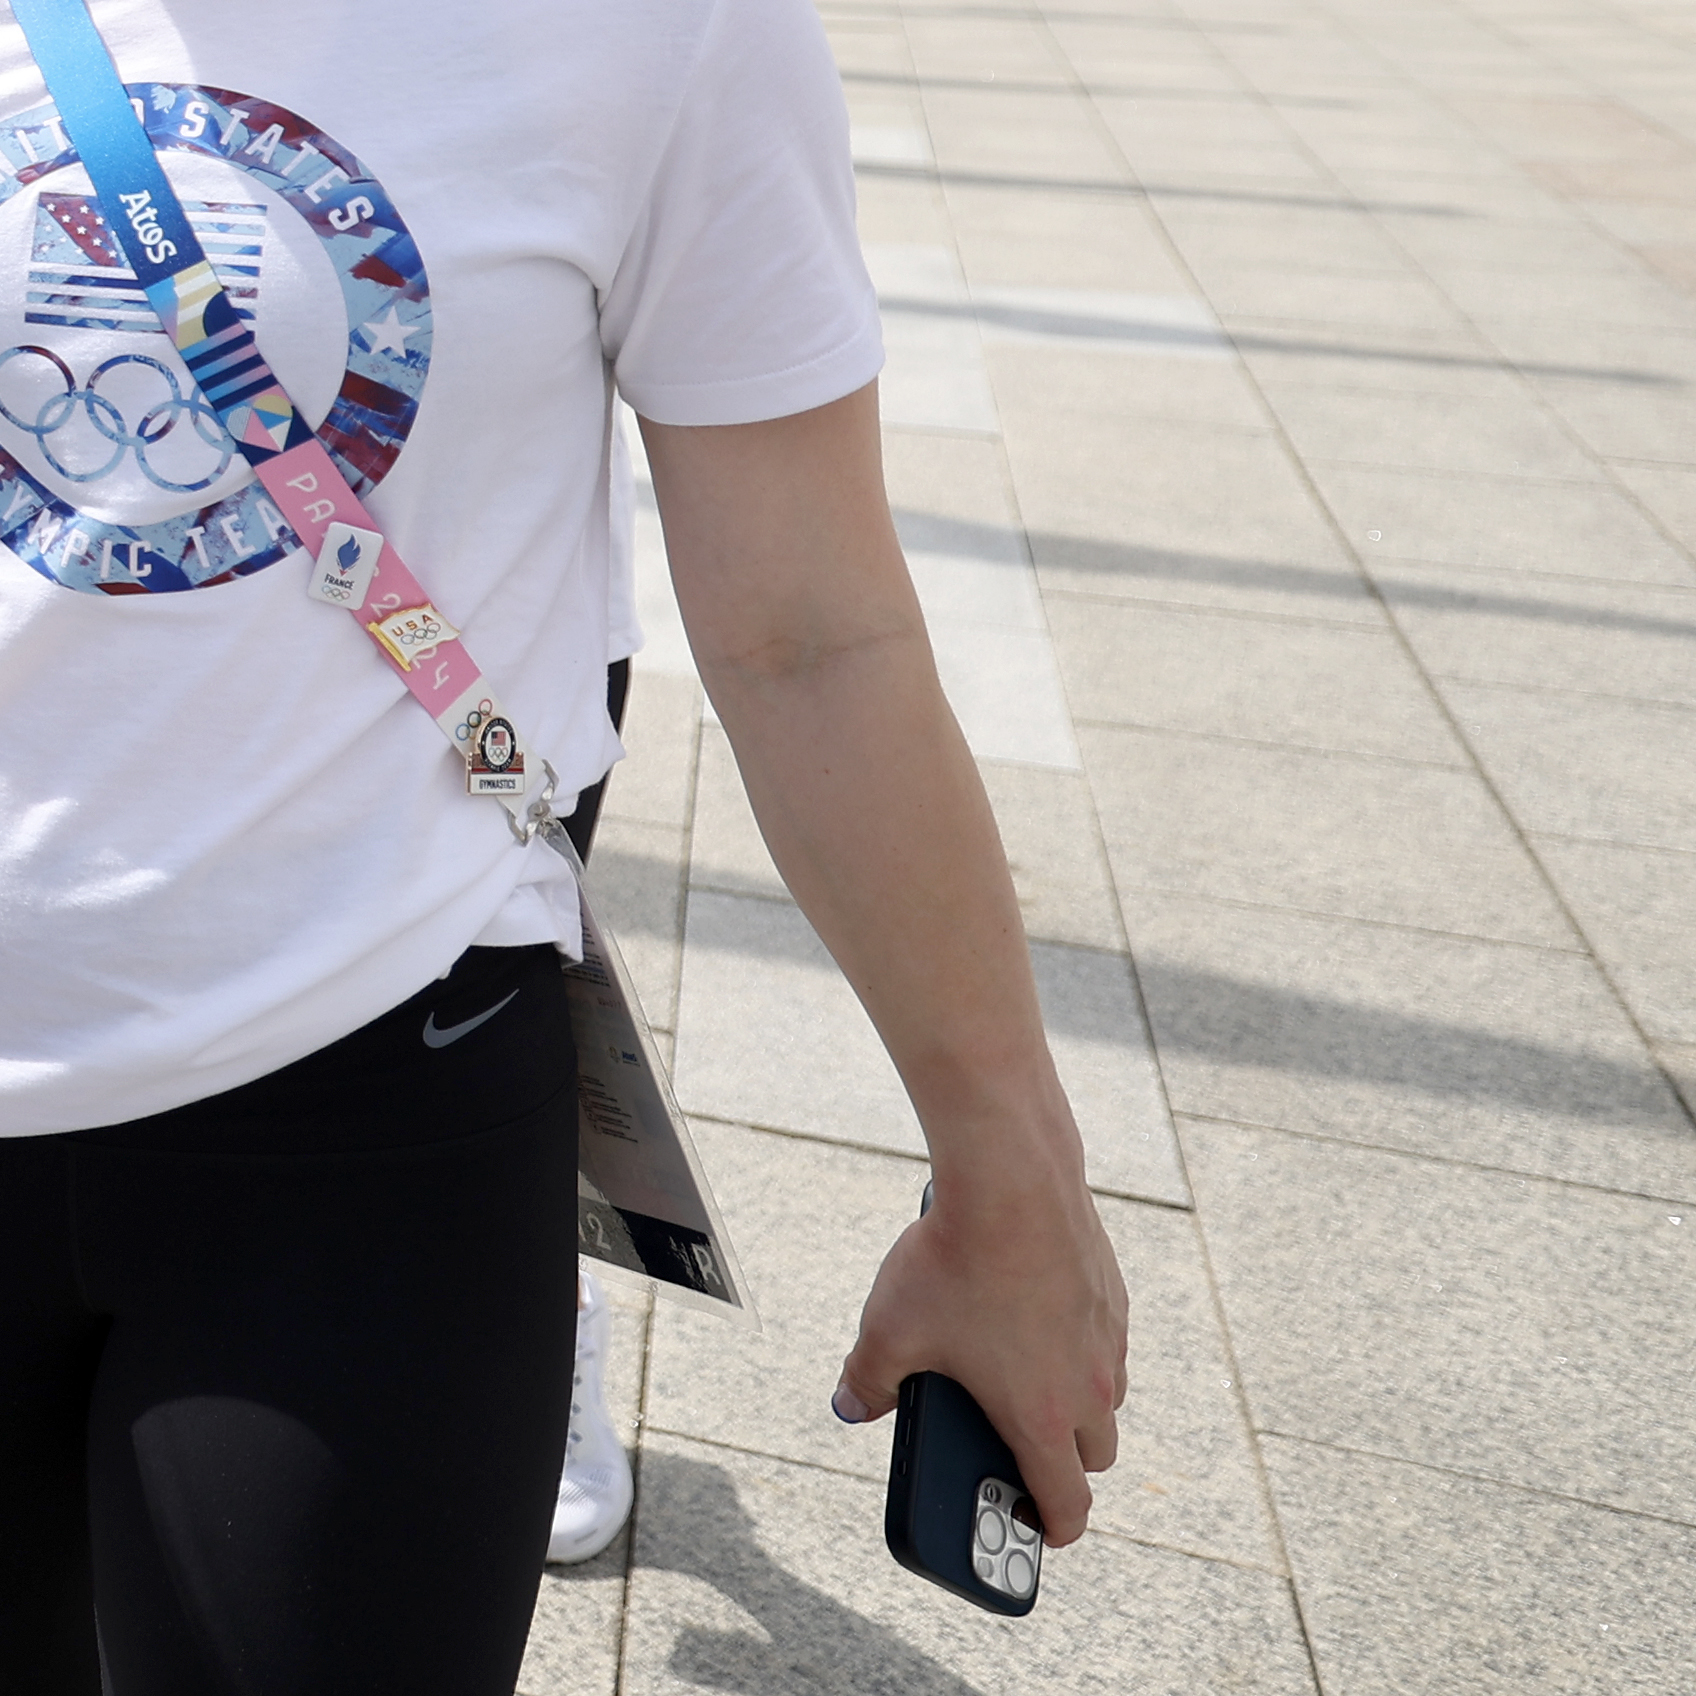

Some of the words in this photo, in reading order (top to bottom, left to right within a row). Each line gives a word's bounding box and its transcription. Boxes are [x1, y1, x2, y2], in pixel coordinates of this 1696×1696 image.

[181, 100, 375, 232] STATES
[119, 189, 178, 265] Atos
[186, 498, 295, 570] TEA
[324, 572, 356, 591] FRANCE
[391, 613, 434, 637] USA
[479, 778, 516, 790] GYMNASTICS
